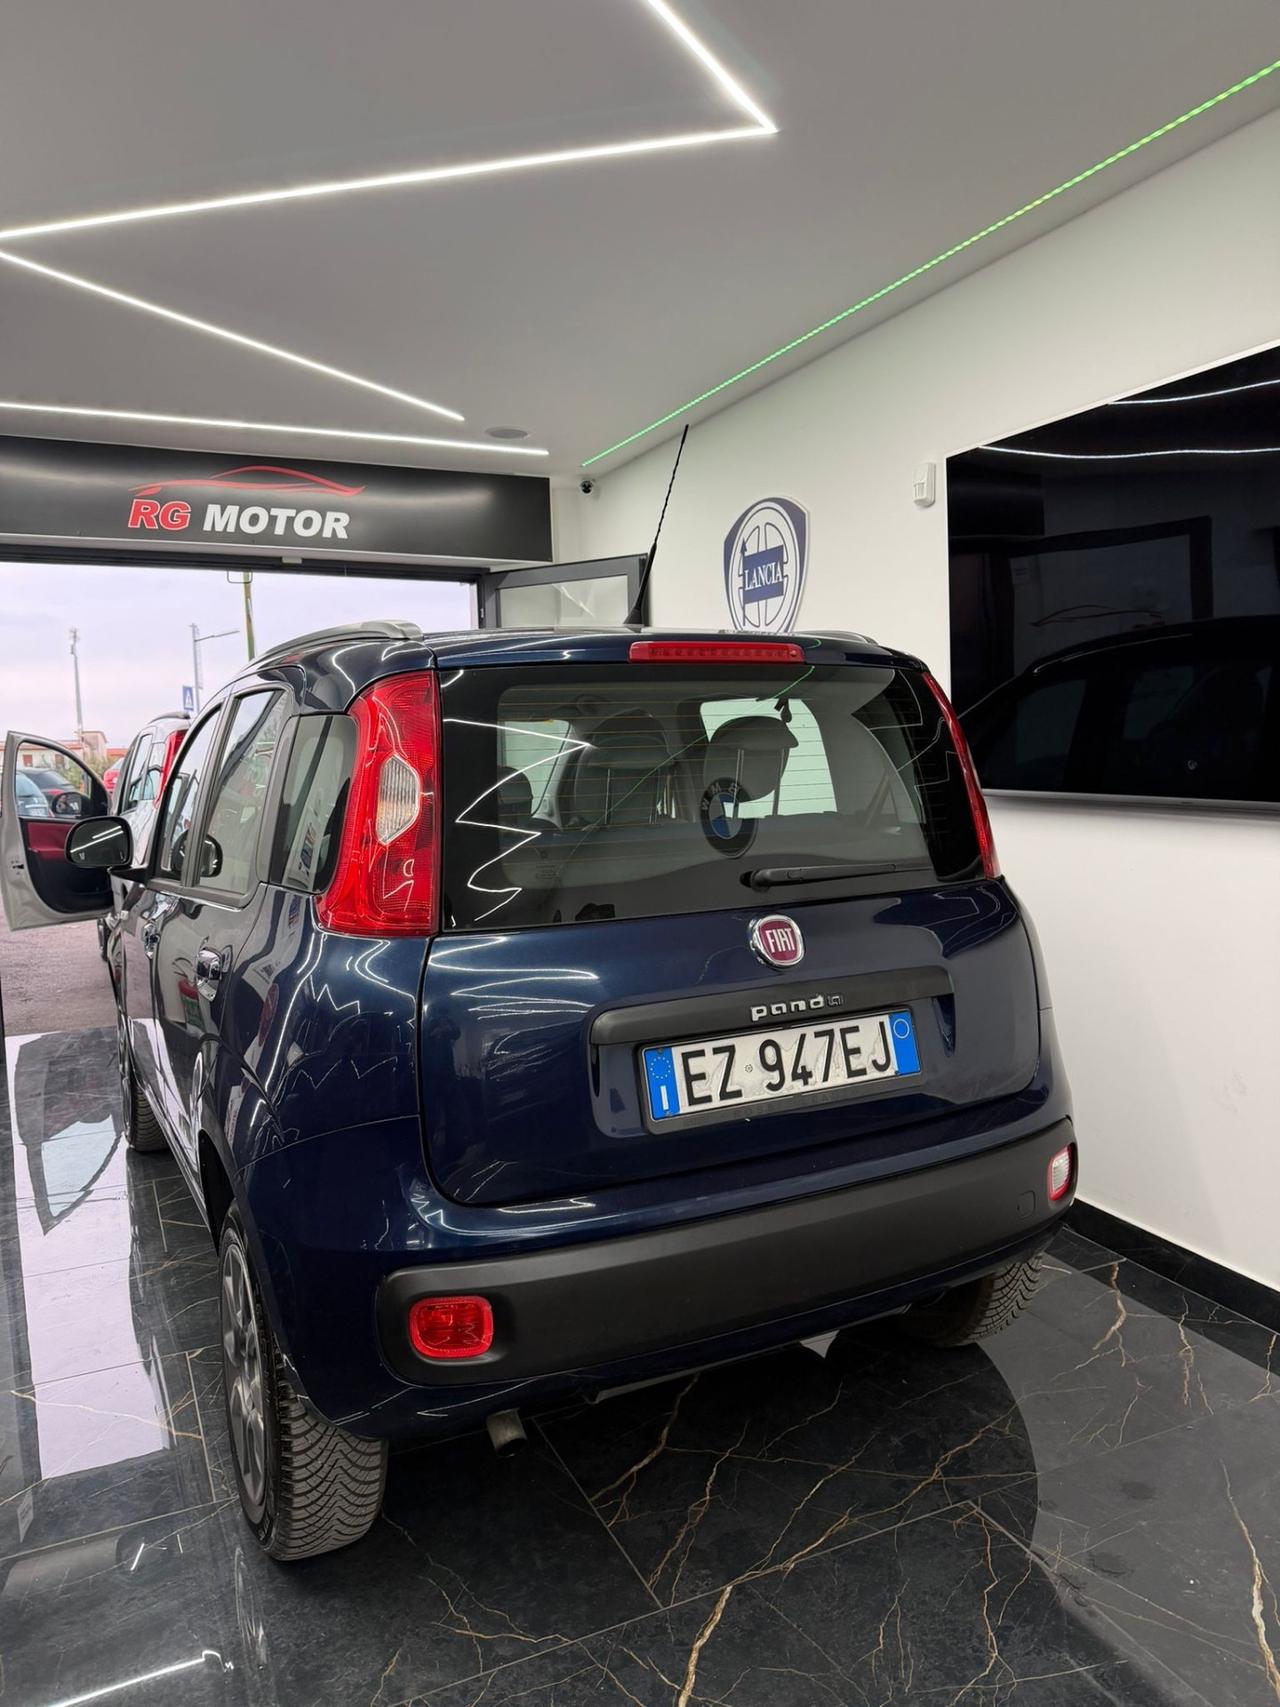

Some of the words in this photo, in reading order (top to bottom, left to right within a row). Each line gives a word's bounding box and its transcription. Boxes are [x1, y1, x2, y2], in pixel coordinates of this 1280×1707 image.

[128, 499, 191, 530] RG
[203, 504, 350, 539] MOTOR
[744, 562, 783, 591] LANCIA
[765, 927, 795, 953] FIAT
[681, 1045, 743, 1107] EZ
